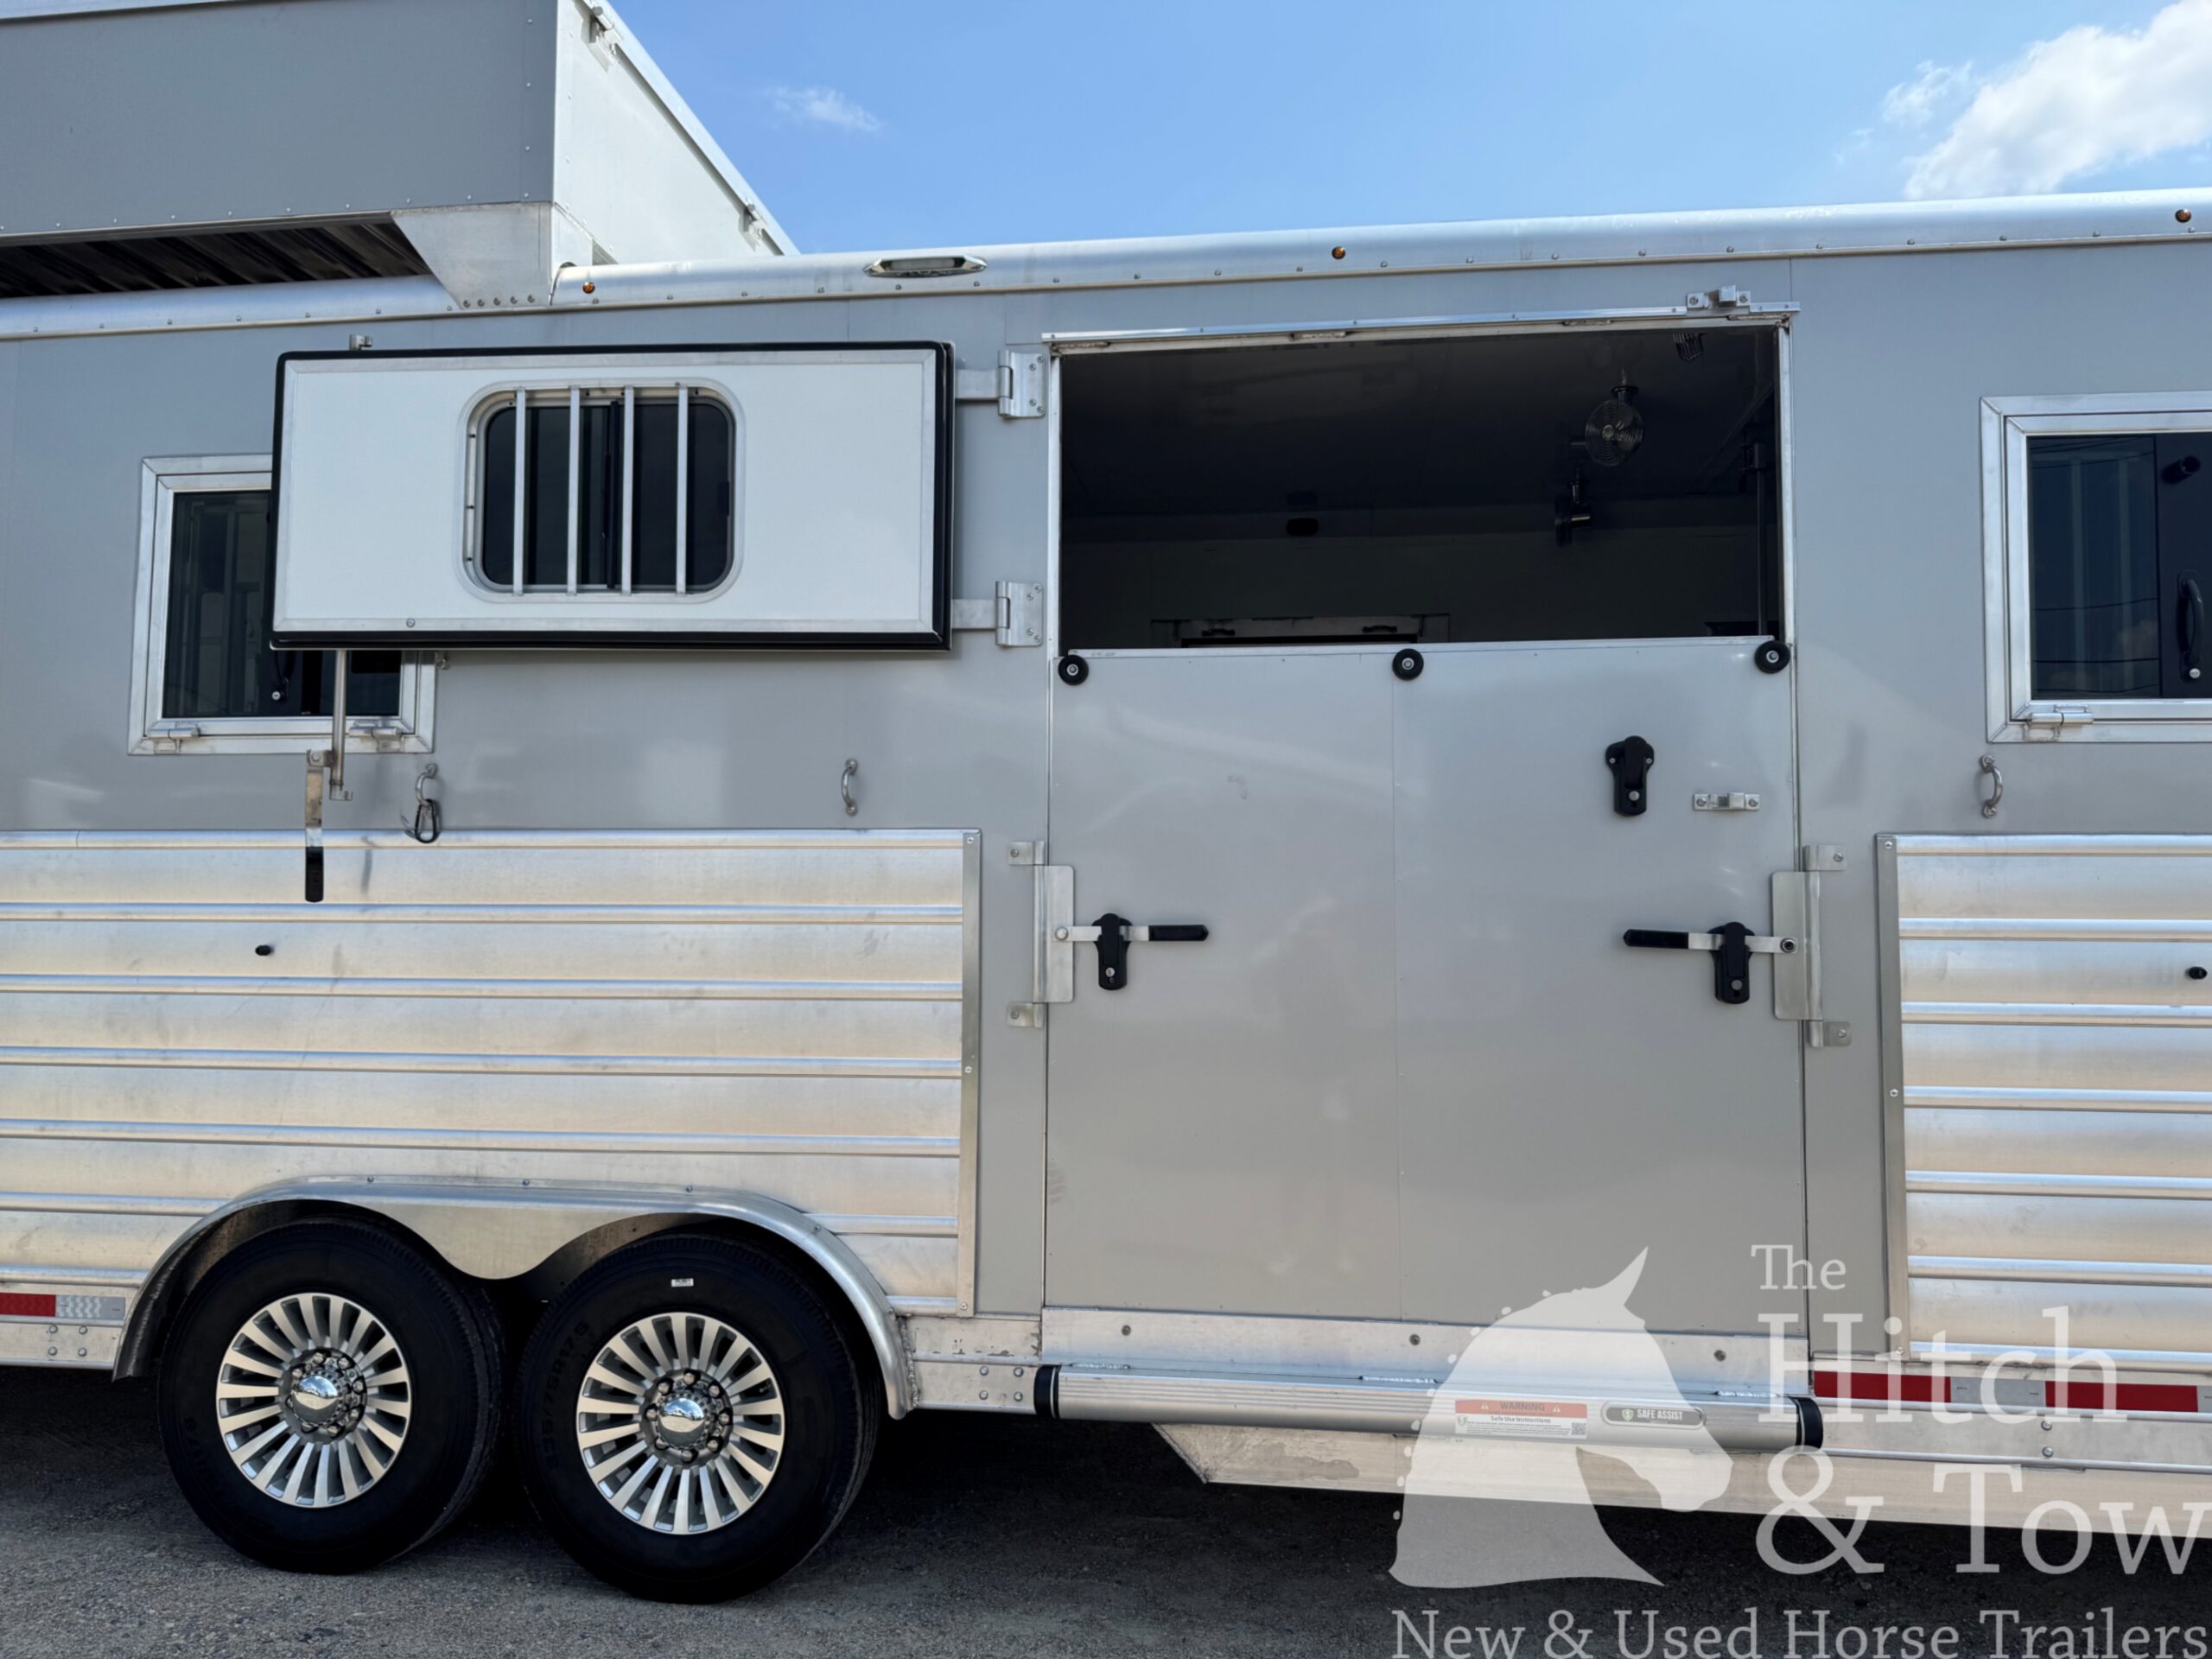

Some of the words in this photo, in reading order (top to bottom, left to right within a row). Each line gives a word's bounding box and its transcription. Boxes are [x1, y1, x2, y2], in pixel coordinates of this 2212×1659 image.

[1499, 1401, 1545, 1411] WARNING
[1637, 1409, 1656, 1419] SAFE
[1657, 1409, 1683, 1421] ASSIST
